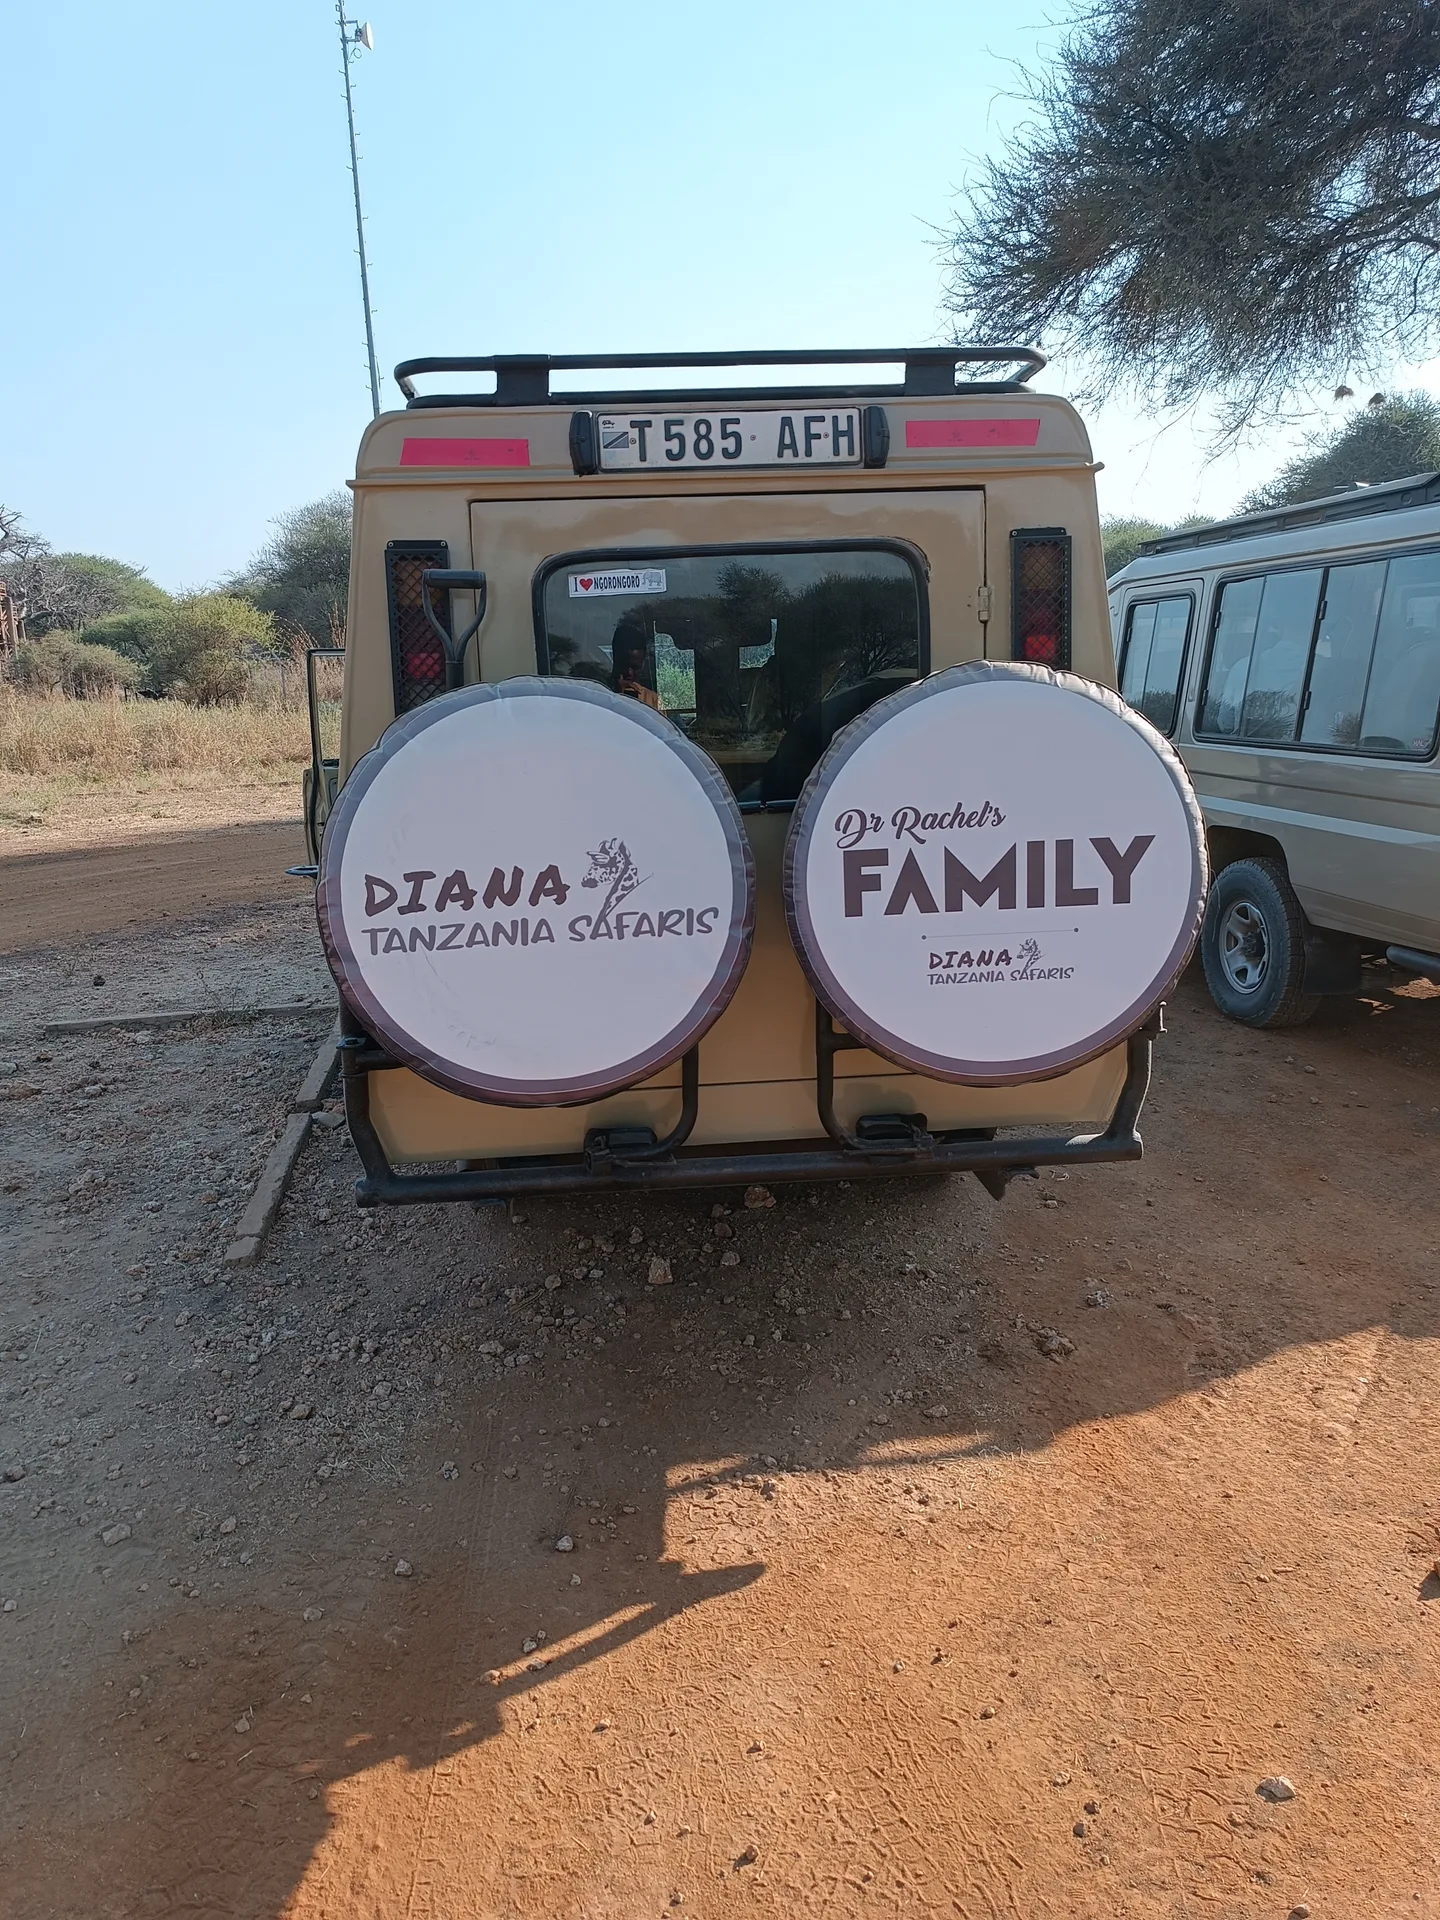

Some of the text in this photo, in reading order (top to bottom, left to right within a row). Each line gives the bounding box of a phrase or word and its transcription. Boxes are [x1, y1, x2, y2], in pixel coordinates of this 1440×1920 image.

[777, 415, 855, 458] AFH
[573, 575, 641, 592] I NGORONGORO
[835, 801, 1006, 849] Dr Rachel's
[365, 864, 571, 917] DIANA
[843, 835, 1156, 917] FAMILY
[361, 907, 719, 955] TANZANIA SAFARIS
[927, 967, 1074, 985] TANZANIA SAFARIS
[929, 949, 1012, 969] DIANA
